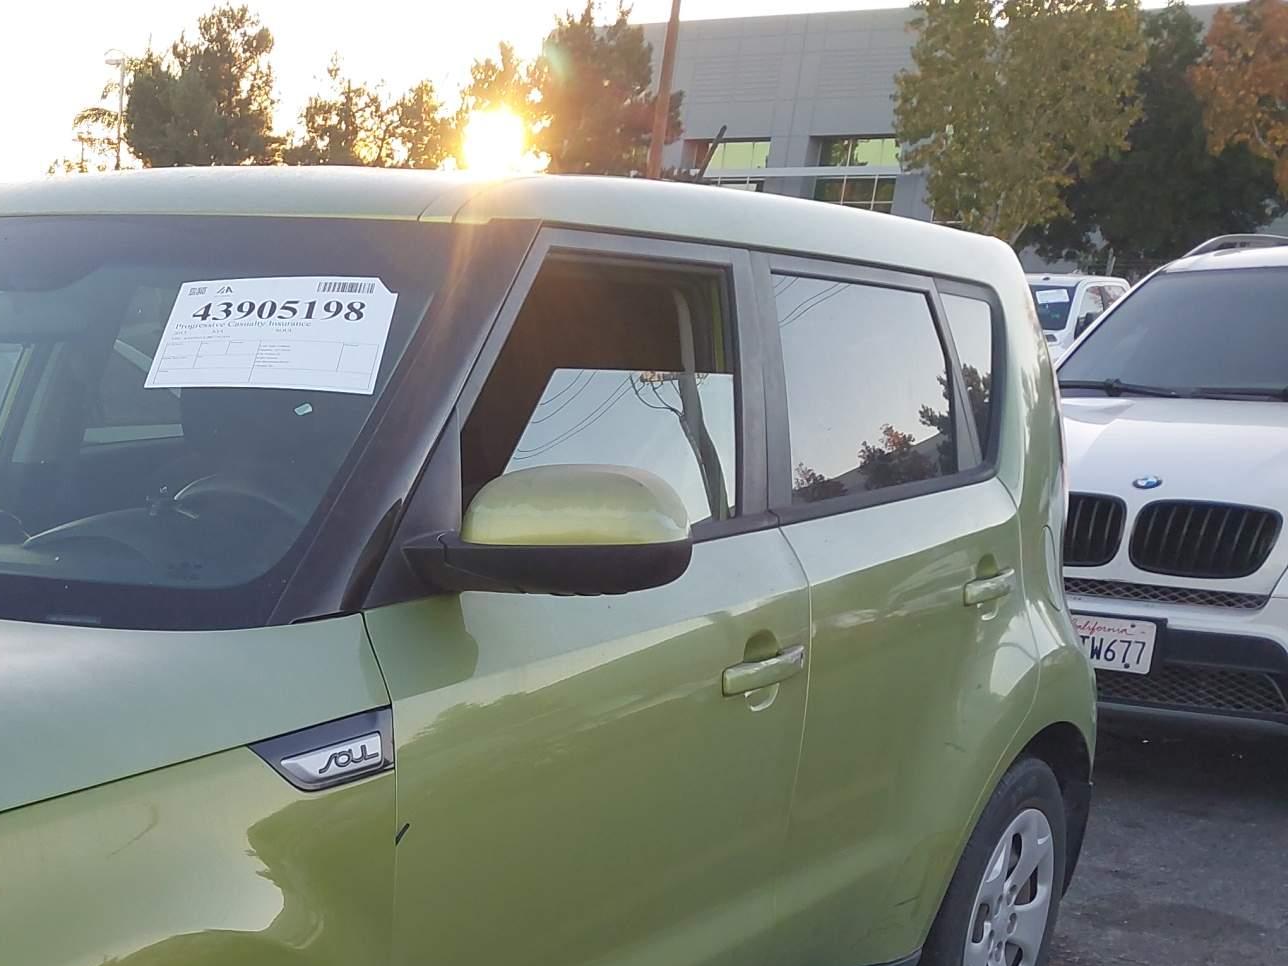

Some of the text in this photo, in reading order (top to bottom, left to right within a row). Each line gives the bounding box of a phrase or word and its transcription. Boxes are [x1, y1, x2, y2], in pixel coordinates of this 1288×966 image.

[192, 300, 367, 322] 43905198
[175, 320, 312, 330] Progressive Casualty Insurance
[1079, 635, 1146, 664] TW677
[318, 744, 380, 774] SOUL
